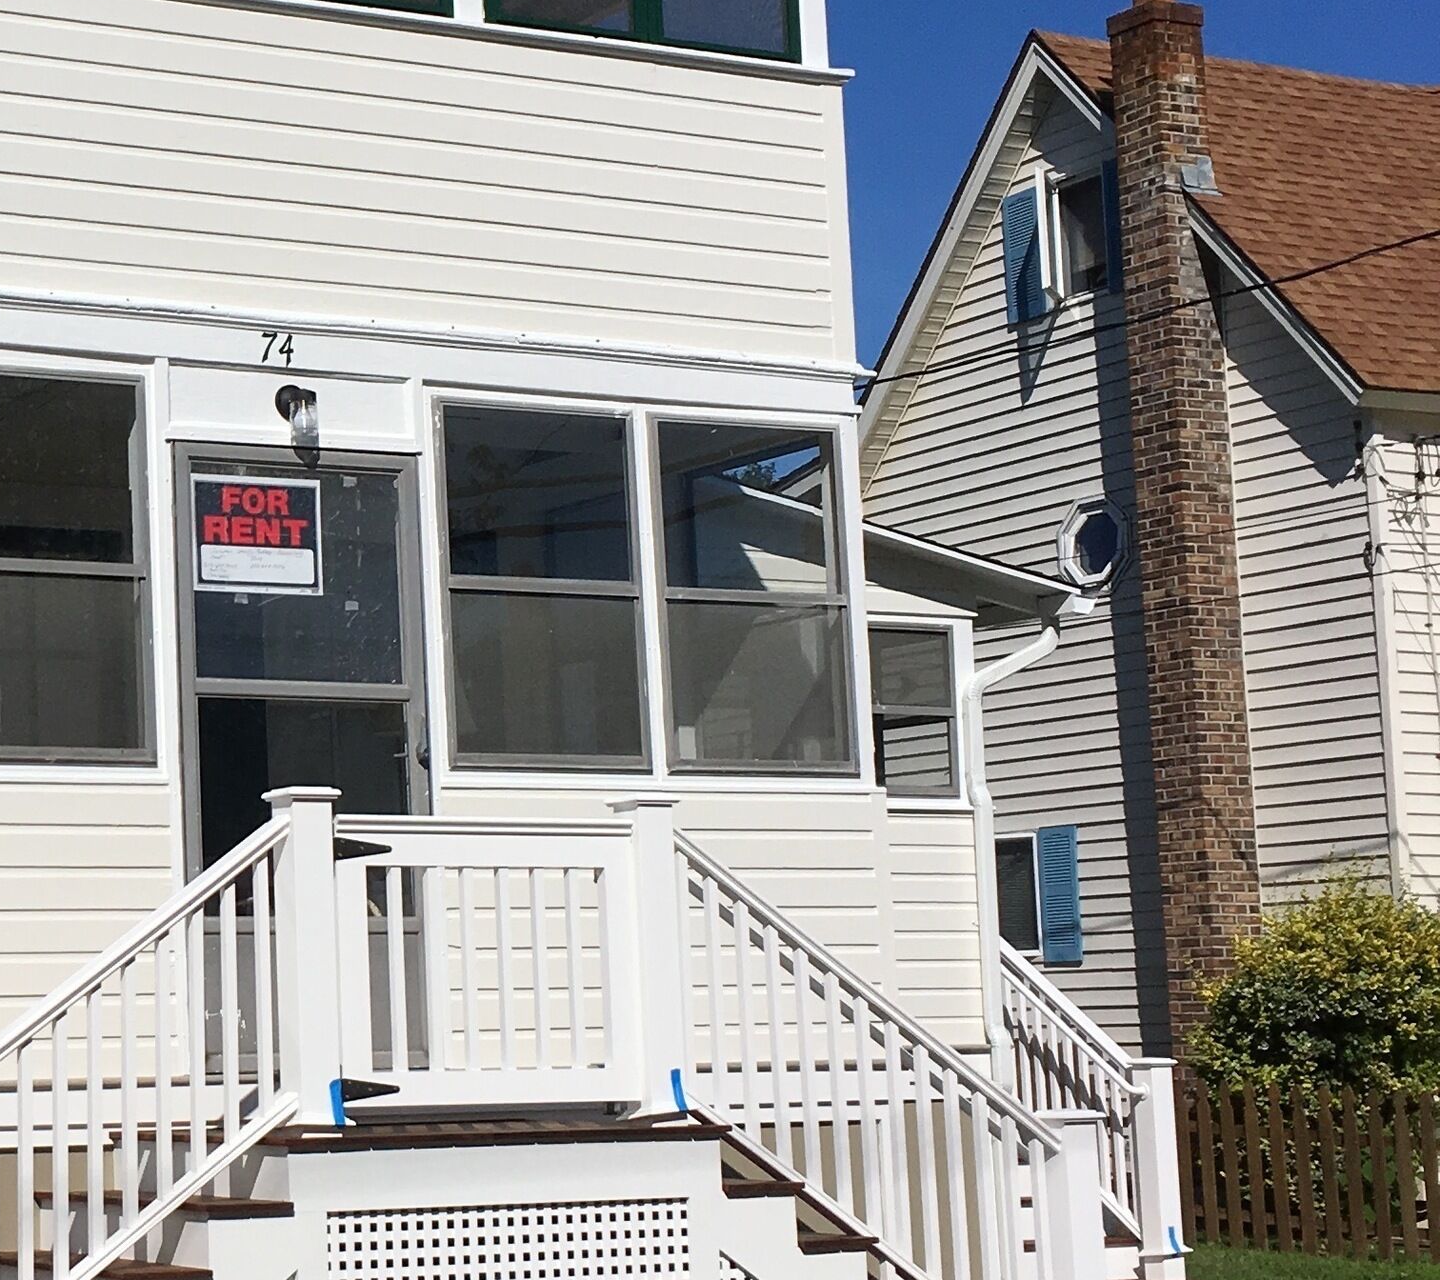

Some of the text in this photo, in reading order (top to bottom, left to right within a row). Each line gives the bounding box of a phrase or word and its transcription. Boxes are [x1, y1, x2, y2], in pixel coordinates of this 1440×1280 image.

[262, 331, 294, 368] 74
[222, 485, 290, 516] FOR
[203, 515, 310, 546] RENT
